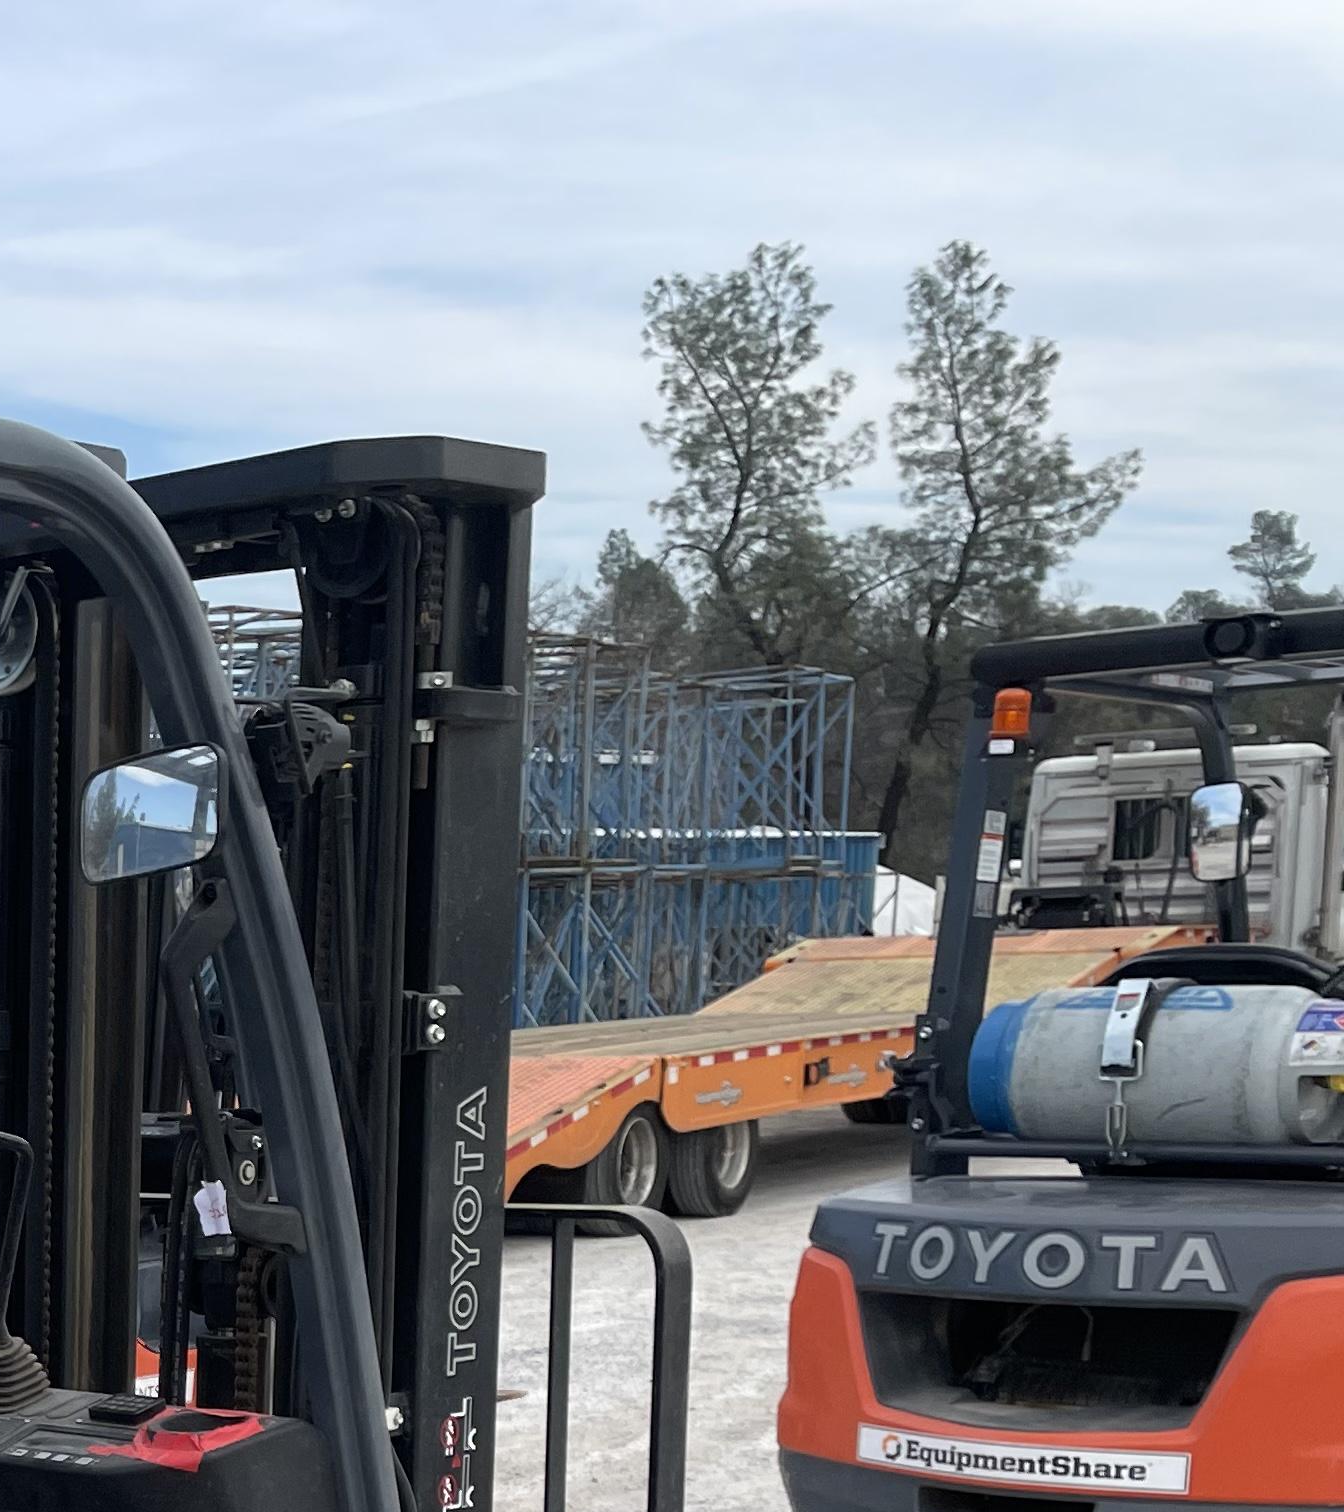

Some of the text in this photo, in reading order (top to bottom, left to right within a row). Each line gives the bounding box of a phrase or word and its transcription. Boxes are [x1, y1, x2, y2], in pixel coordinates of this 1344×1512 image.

[447, 1086, 488, 1376] TOYOTA
[875, 1222, 1228, 1293] TOYOTA
[906, 1439, 1147, 1481] EquipmentShare
